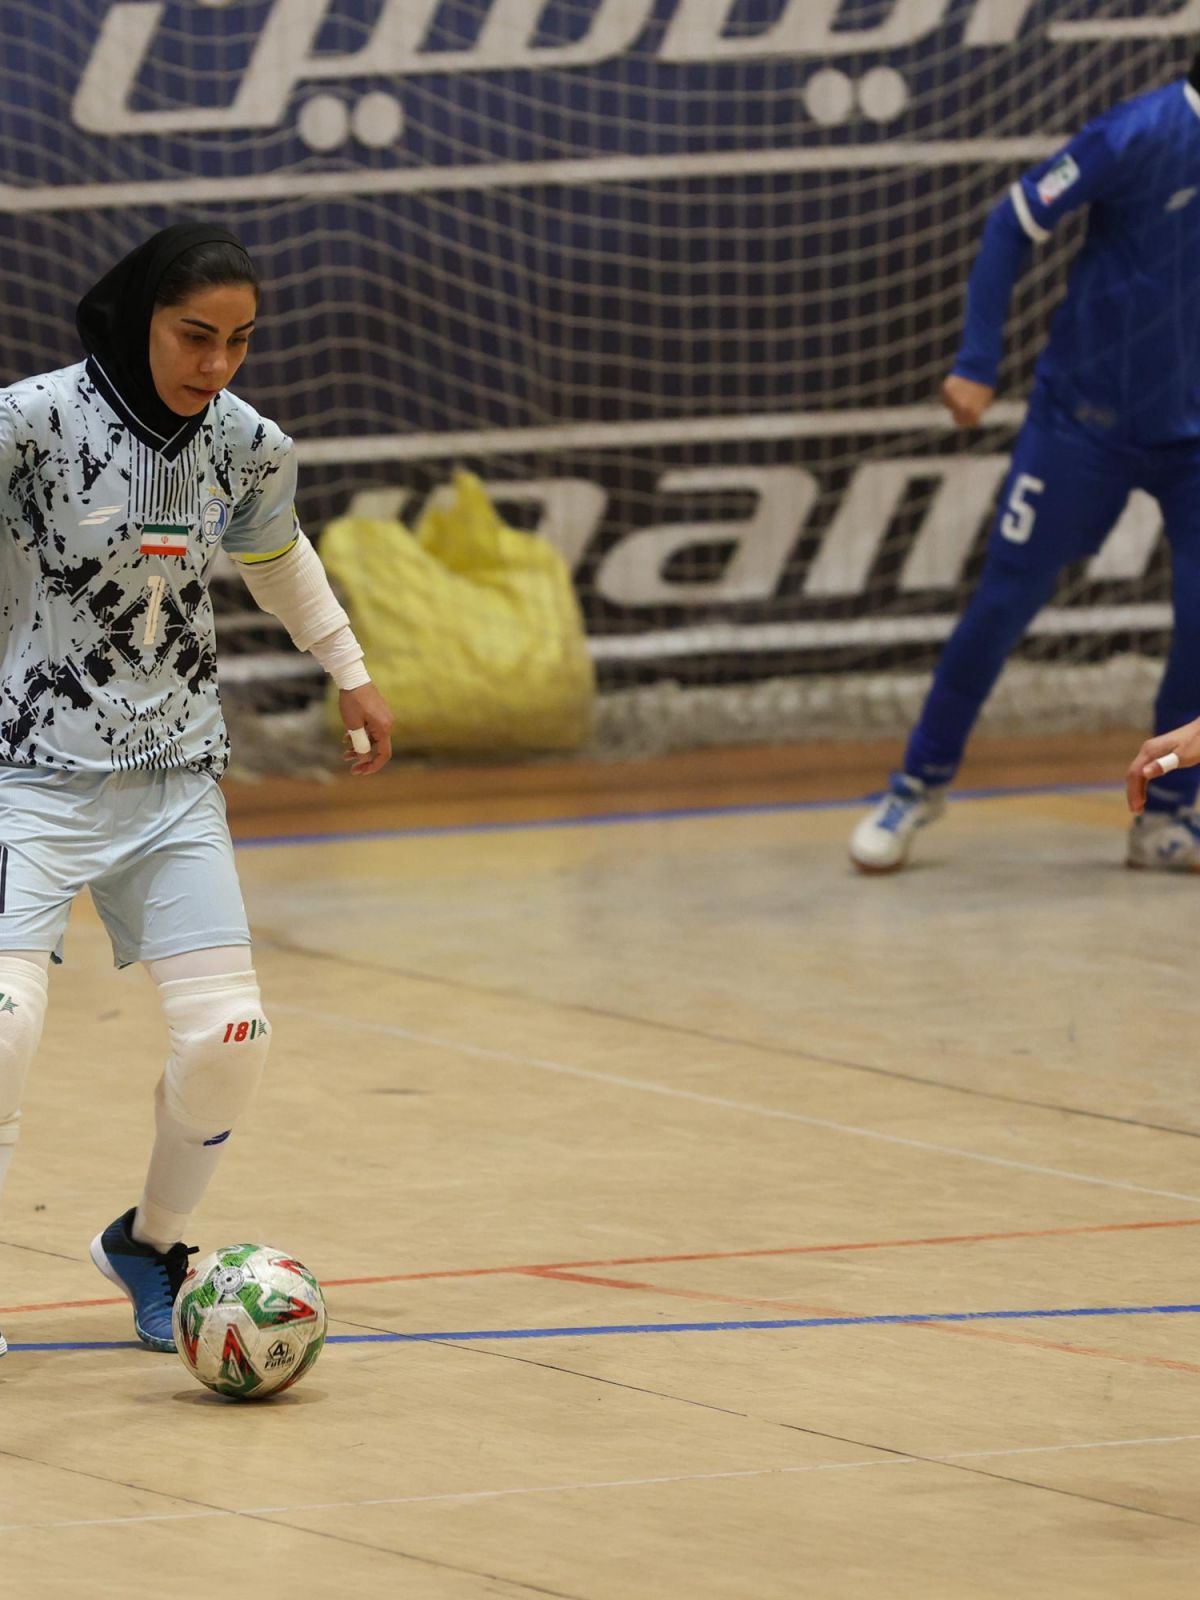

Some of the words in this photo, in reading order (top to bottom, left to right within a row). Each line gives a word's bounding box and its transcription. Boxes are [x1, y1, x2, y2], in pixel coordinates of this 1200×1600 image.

[1001, 474, 1044, 543] 5
[143, 576, 166, 645] 1
[223, 1019, 257, 1043] 181
[264, 1353, 295, 1369] Futsal
[272, 1342, 286, 1357] 4
